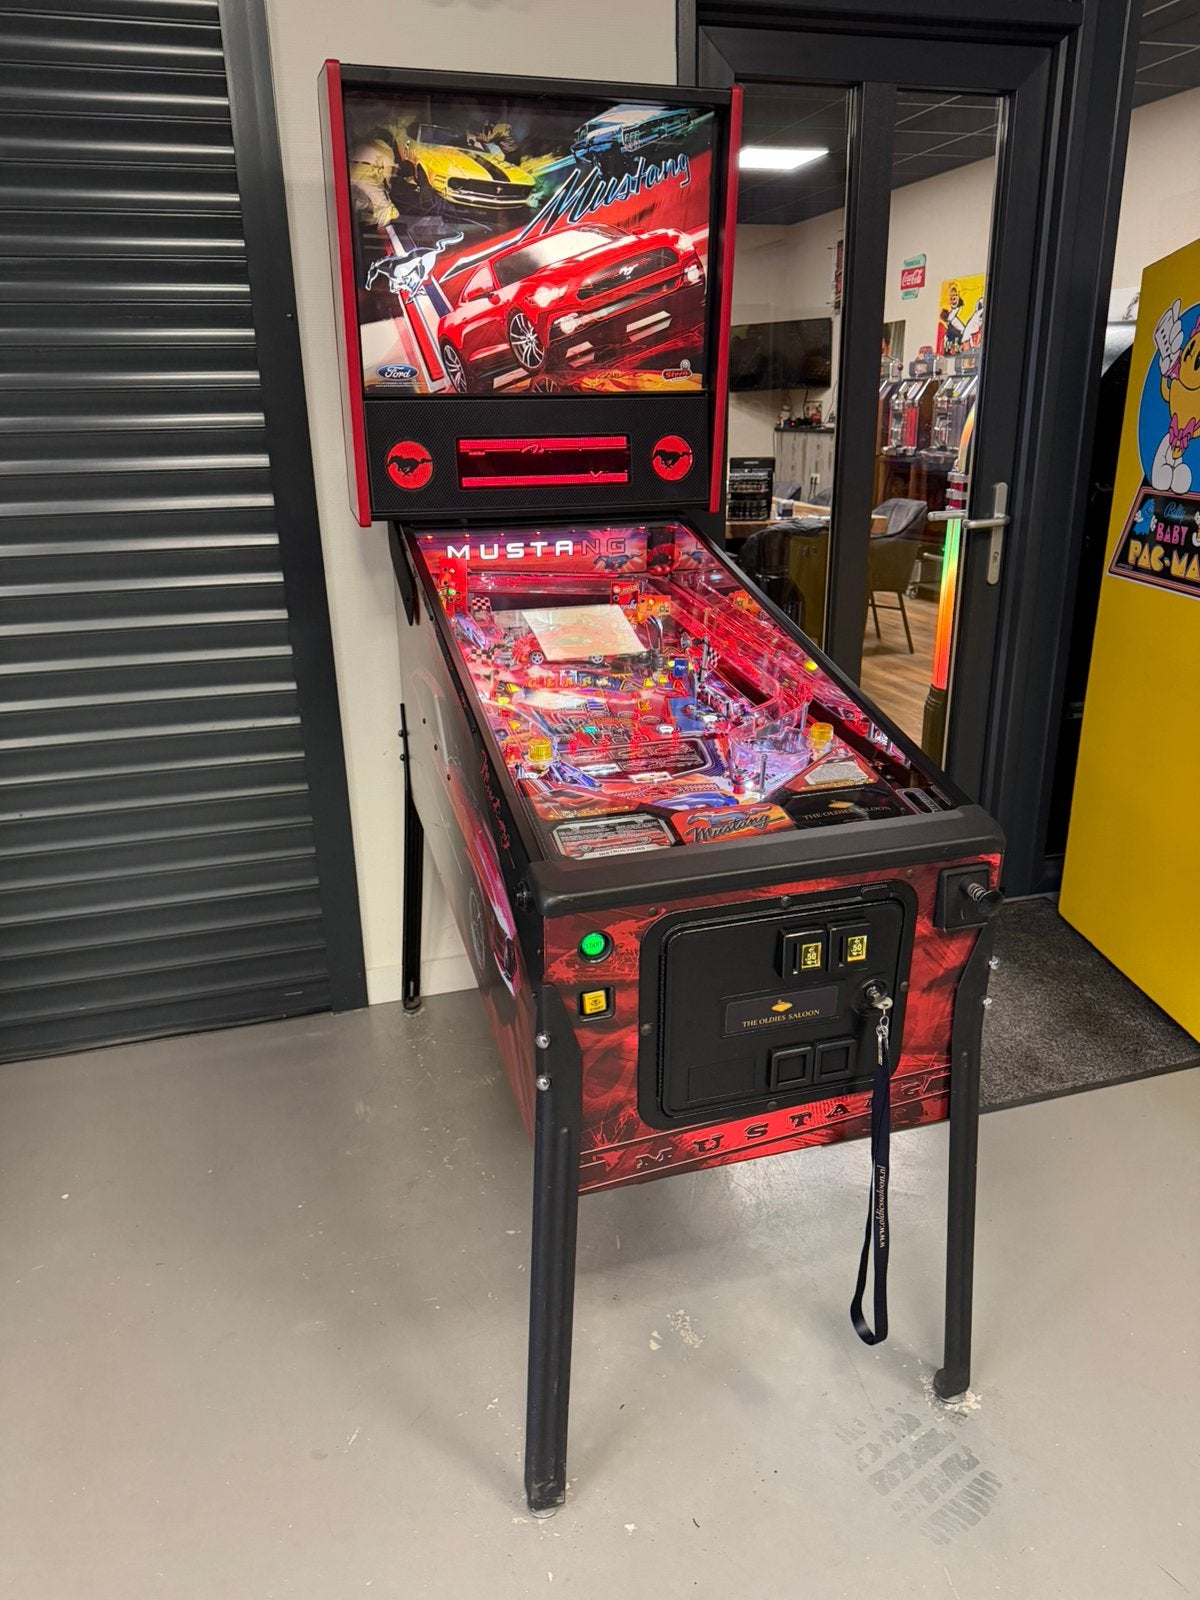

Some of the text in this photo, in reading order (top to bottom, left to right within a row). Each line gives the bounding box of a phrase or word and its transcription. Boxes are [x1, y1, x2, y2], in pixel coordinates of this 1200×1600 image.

[497, 153, 691, 248] Mustang
[384, 366, 411, 378] Ford
[664, 370, 689, 379] Stern
[1164, 501, 1185, 523] Bally
[1156, 522, 1189, 546] BABY
[445, 537, 626, 561] MUSTANG
[684, 812, 785, 844] Mustang
[741, 1009, 820, 1028] THE OLDIES SALOON
[635, 1079, 924, 1169] MUSTAG
[875, 1164, 887, 1249] www.oldiessaloon.nl
